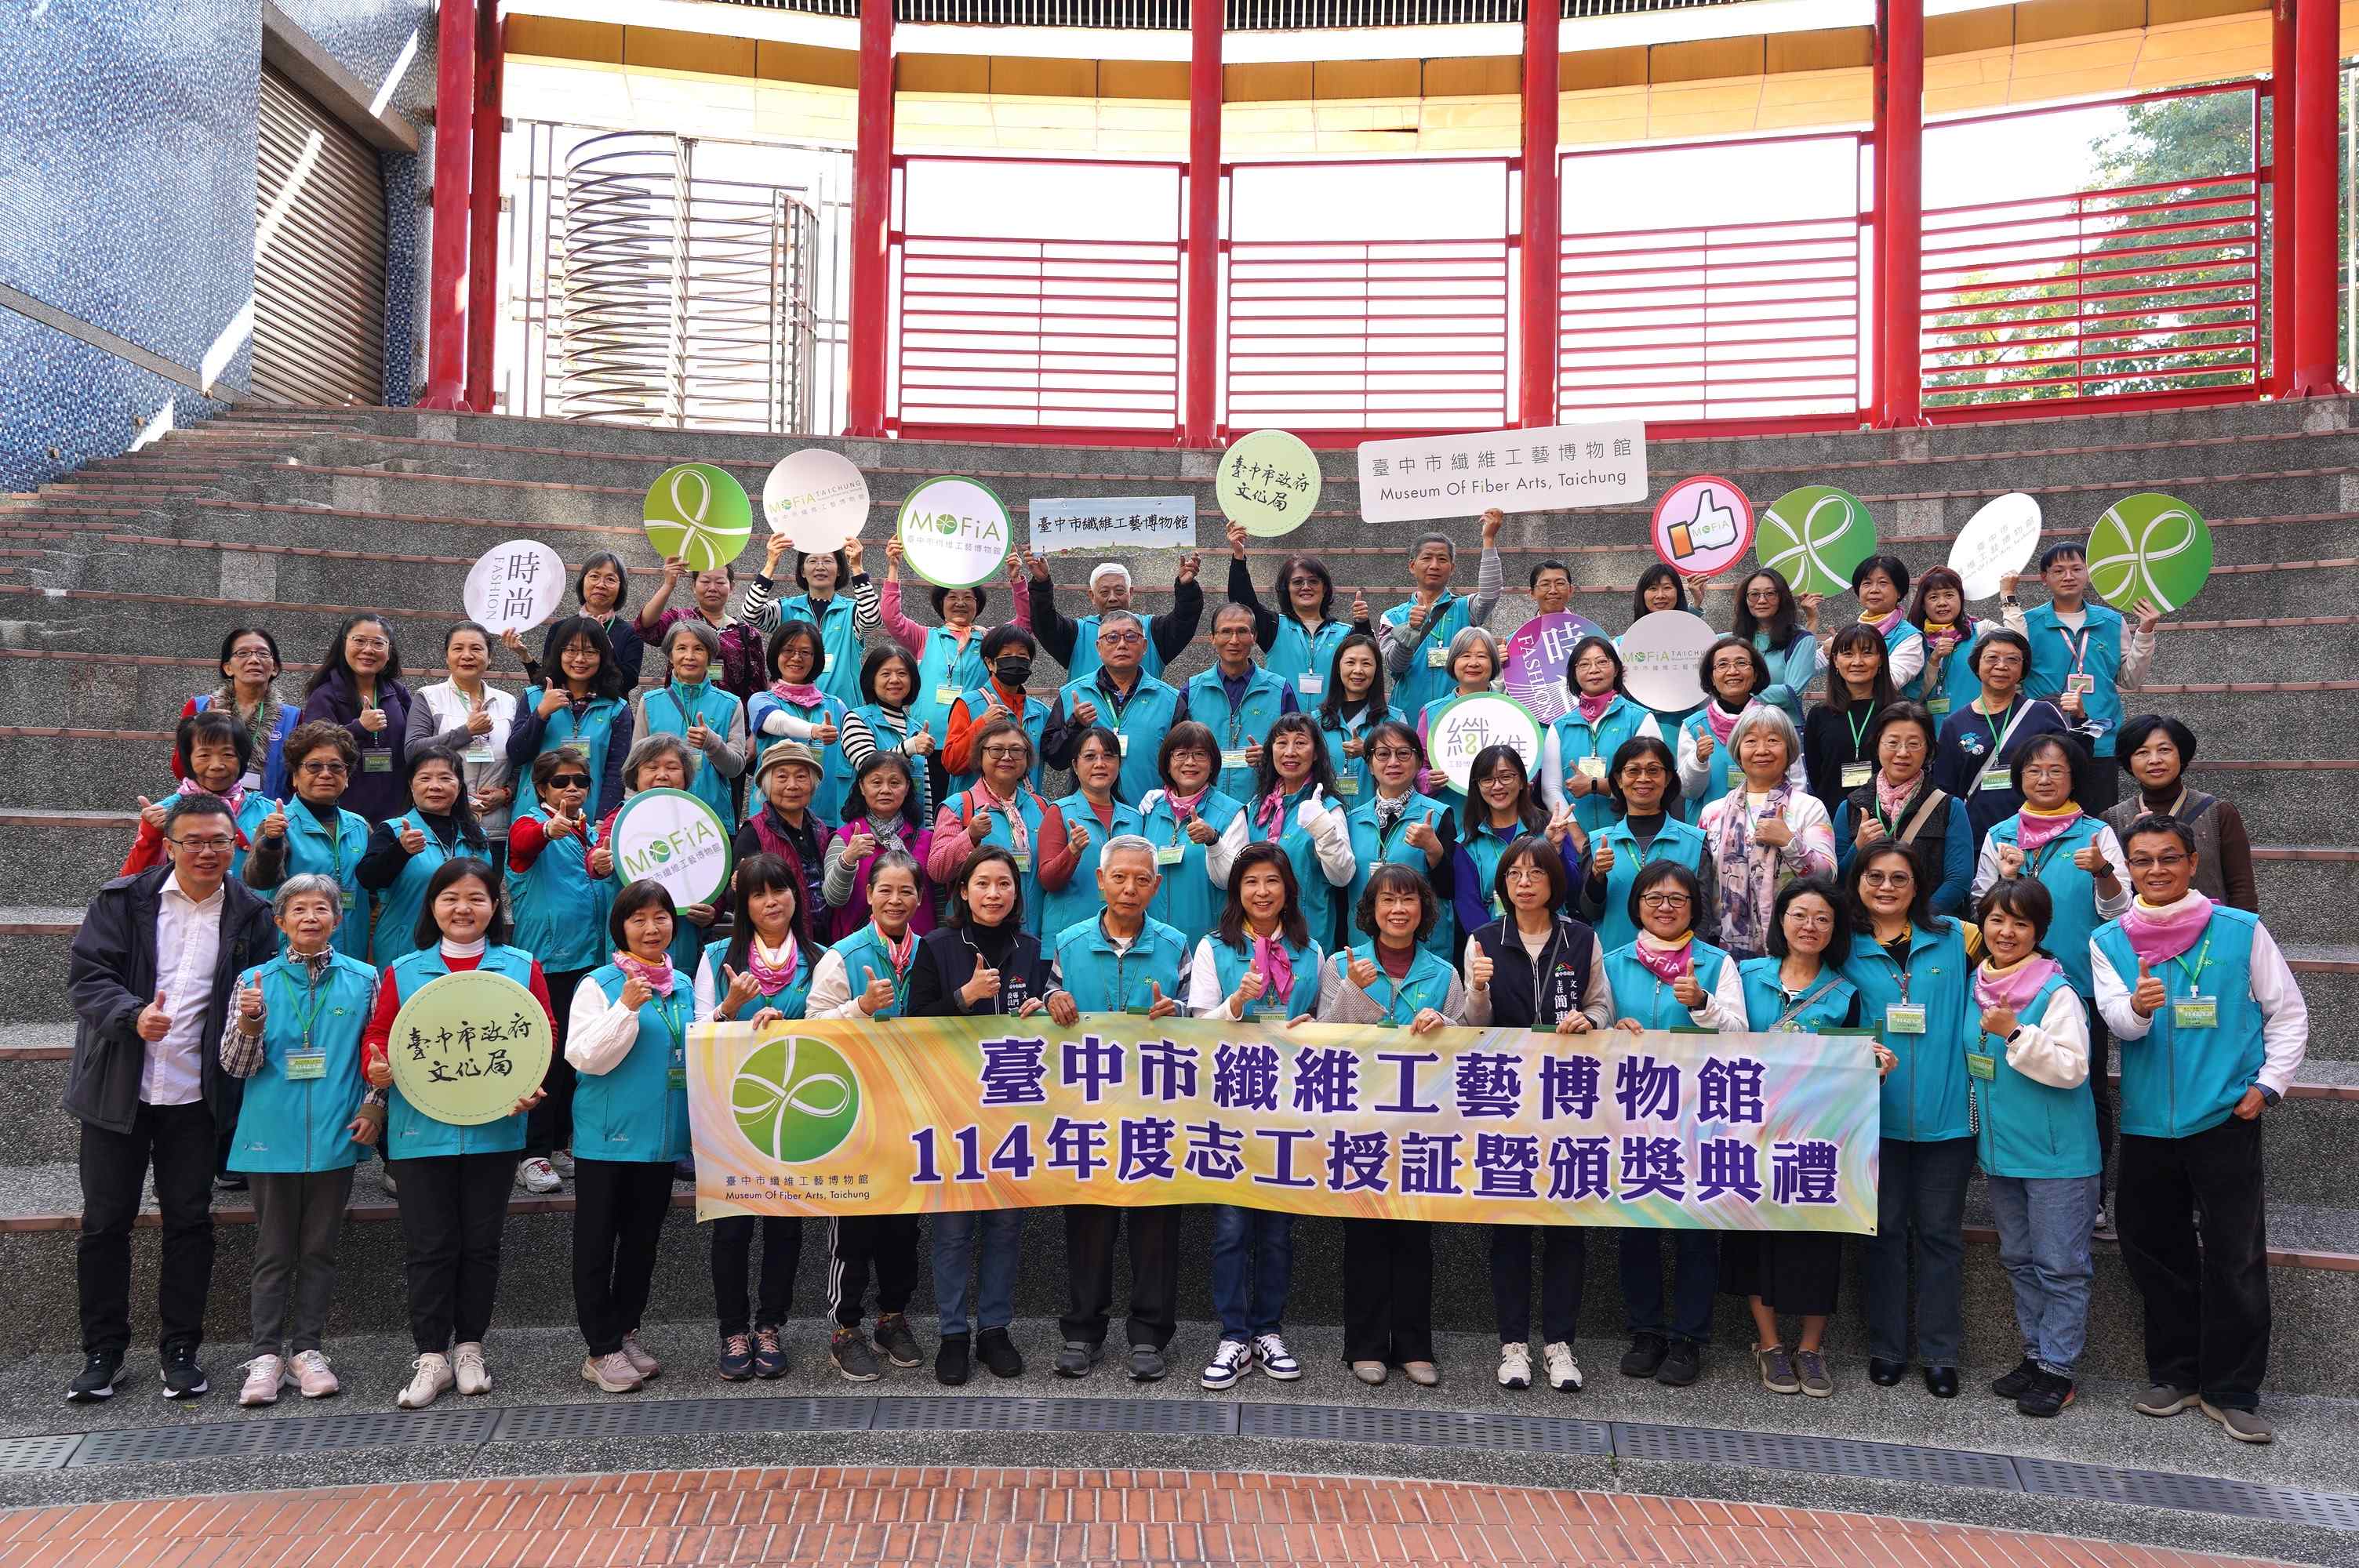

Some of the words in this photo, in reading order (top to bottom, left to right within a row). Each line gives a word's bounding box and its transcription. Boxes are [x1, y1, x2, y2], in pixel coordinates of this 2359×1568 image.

[1231, 455, 1310, 492] 臺中市政府
[1372, 438, 1632, 477] 臺中市纖維工藝博物館
[816, 480, 862, 496] TAICHUNG
[1234, 481, 1288, 512] 文化局
[1380, 487, 1441, 501] Museum
[1447, 481, 1467, 495] Of
[1472, 478, 1510, 494] Fiber
[1516, 477, 1552, 491] Arts,
[1558, 470, 1627, 487] Taichung
[1038, 514, 1189, 533] 臺中市纖維工藝博物館
[486, 557, 505, 620] FASHION
[503, 551, 540, 621] 時尚
[1518, 634, 1555, 719] FASHION
[406, 1012, 532, 1060] 臺中市政府
[427, 1049, 513, 1083] 文化局
[981, 1038, 1765, 1123] 臺中市纖維工藝博物館
[913, 1117, 1837, 1203] 114年度志工授証暨頒獎典禮
[726, 1174, 869, 1186] 臺中市纖維工藝博物館
[780, 1191, 801, 1200] Fiber
[805, 1191, 827, 1200] Arts,
[831, 1190, 870, 1200] Taichung
